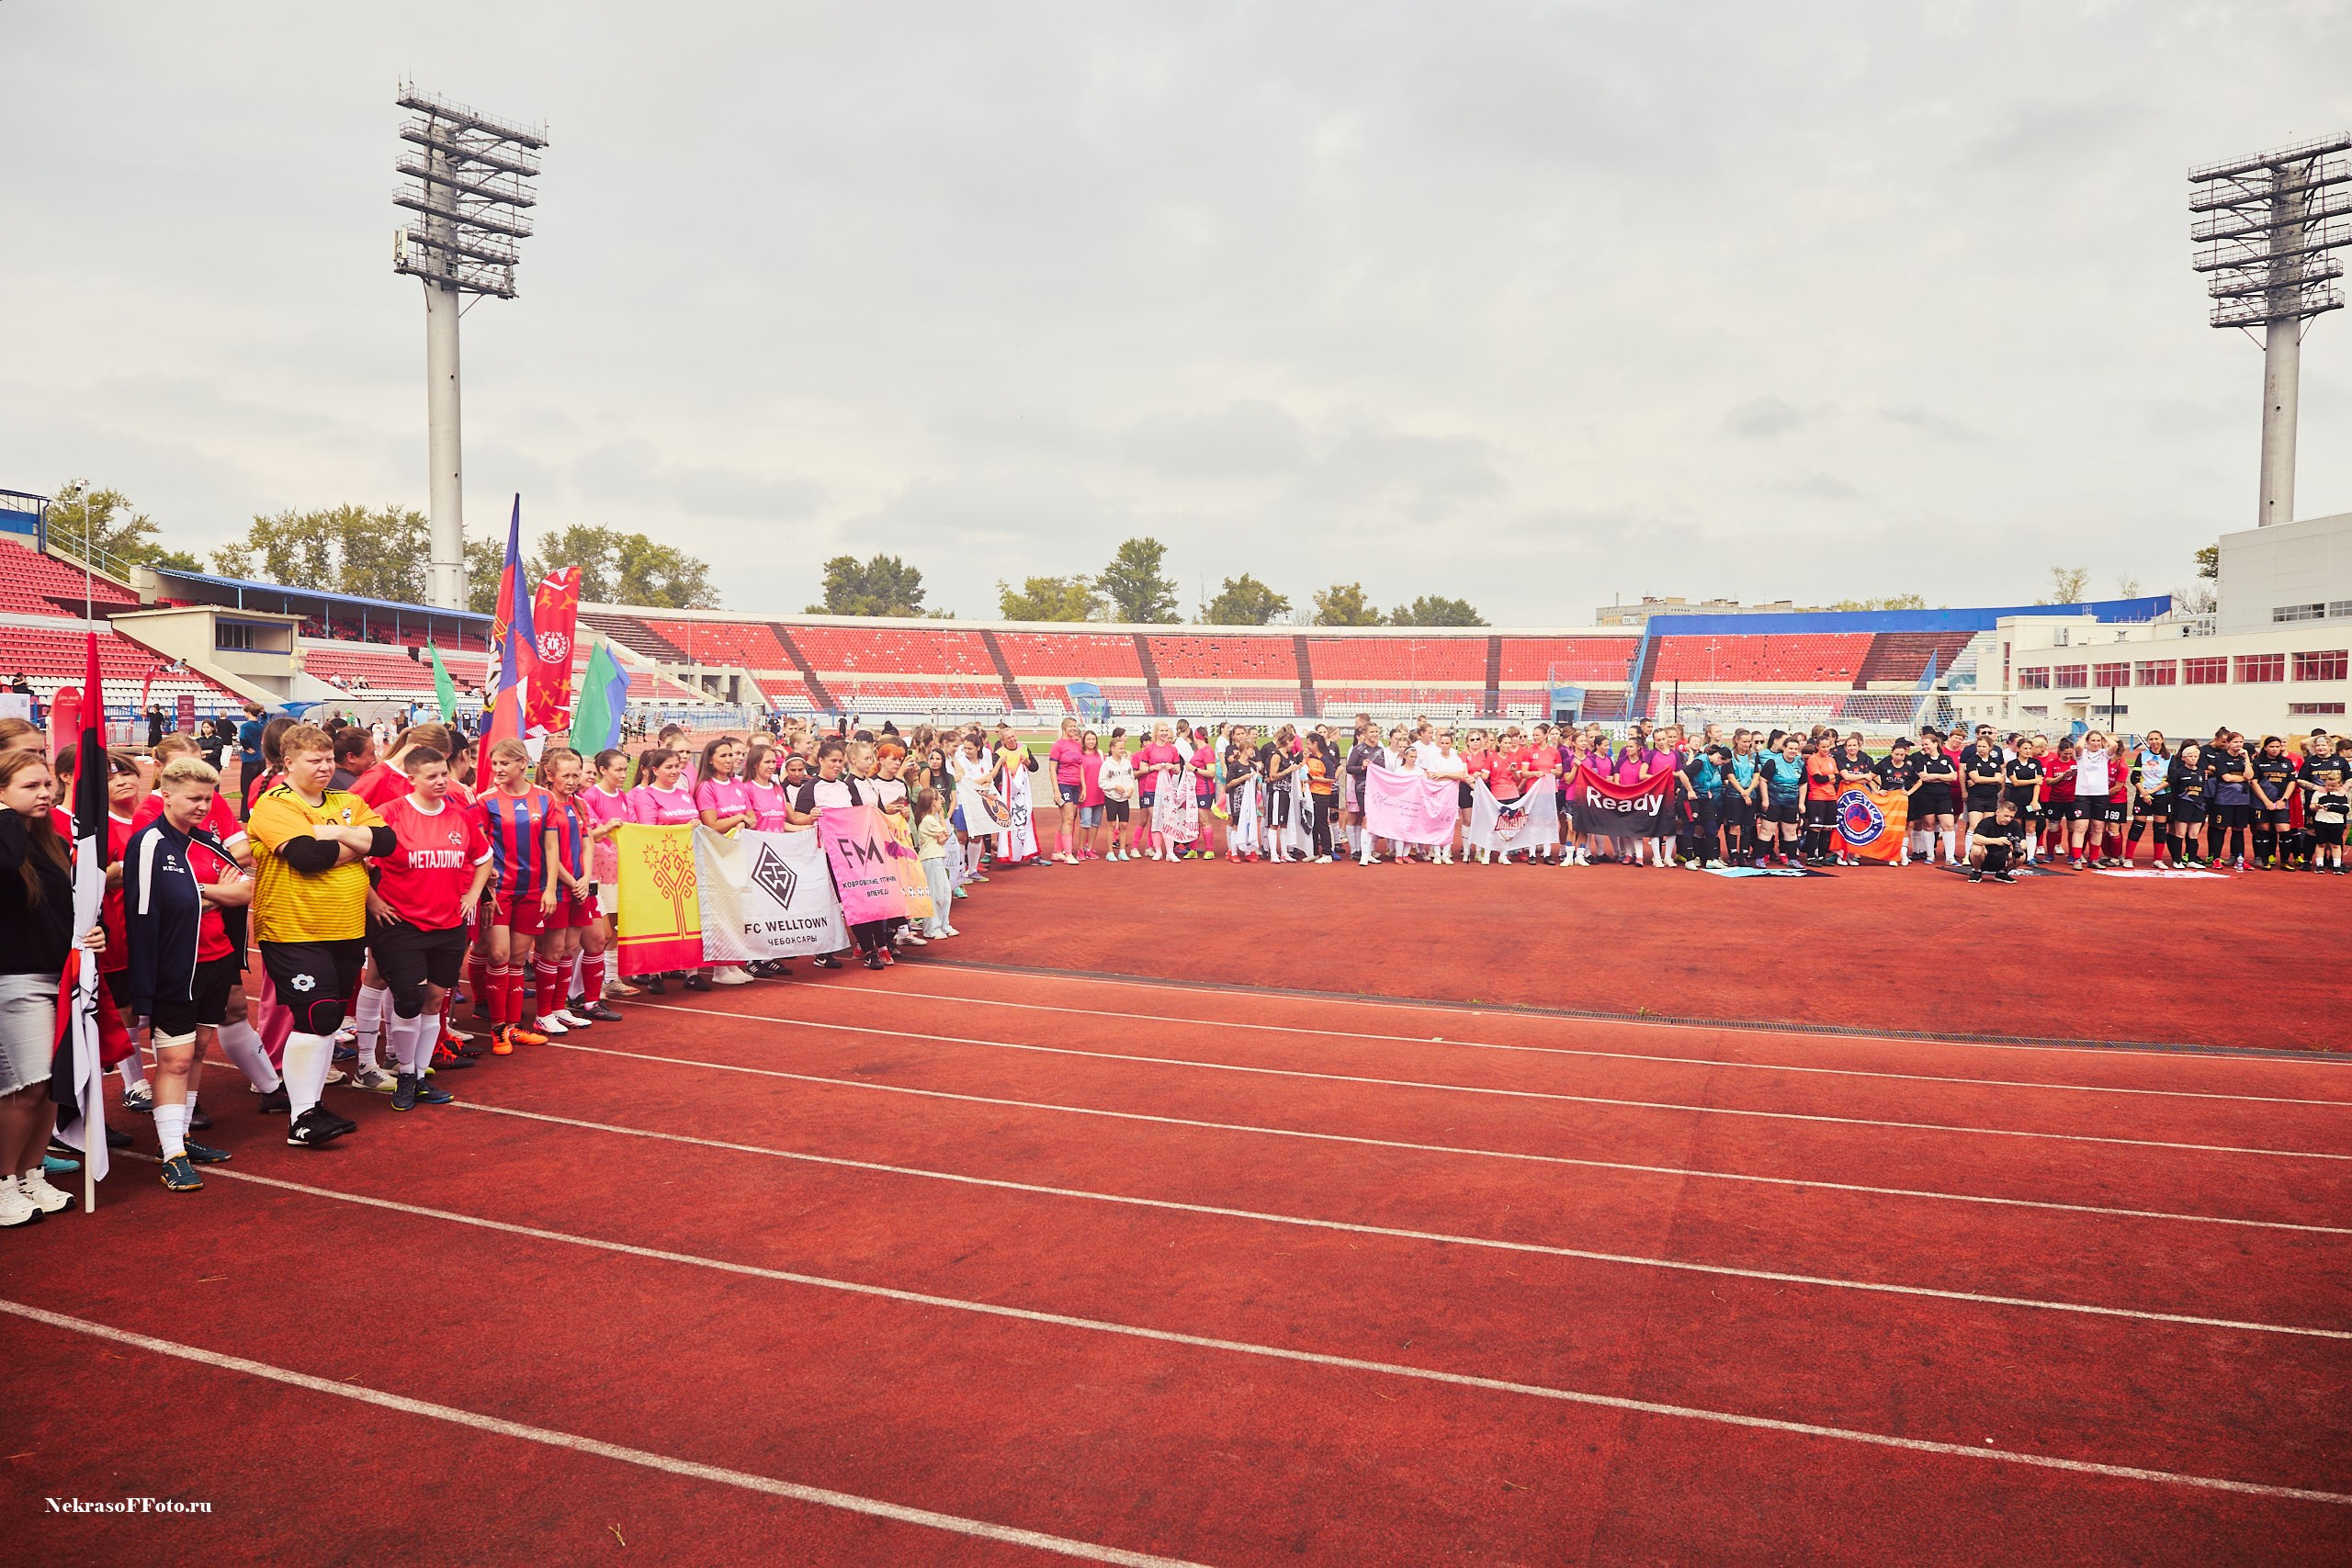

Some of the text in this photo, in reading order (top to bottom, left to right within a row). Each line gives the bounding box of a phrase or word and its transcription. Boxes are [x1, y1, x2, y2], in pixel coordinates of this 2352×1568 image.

[1586, 785, 1664, 817] Ready
[2109, 810, 2120, 820] 69
[408, 850, 466, 869] МЕТАЛЛИСТ
[842, 878, 879, 889] КОВРОВСКИЕ
[744, 917, 828, 934] FC WELLTOWN
[767, 936, 818, 947] ЧЕБОКСАРЫ
